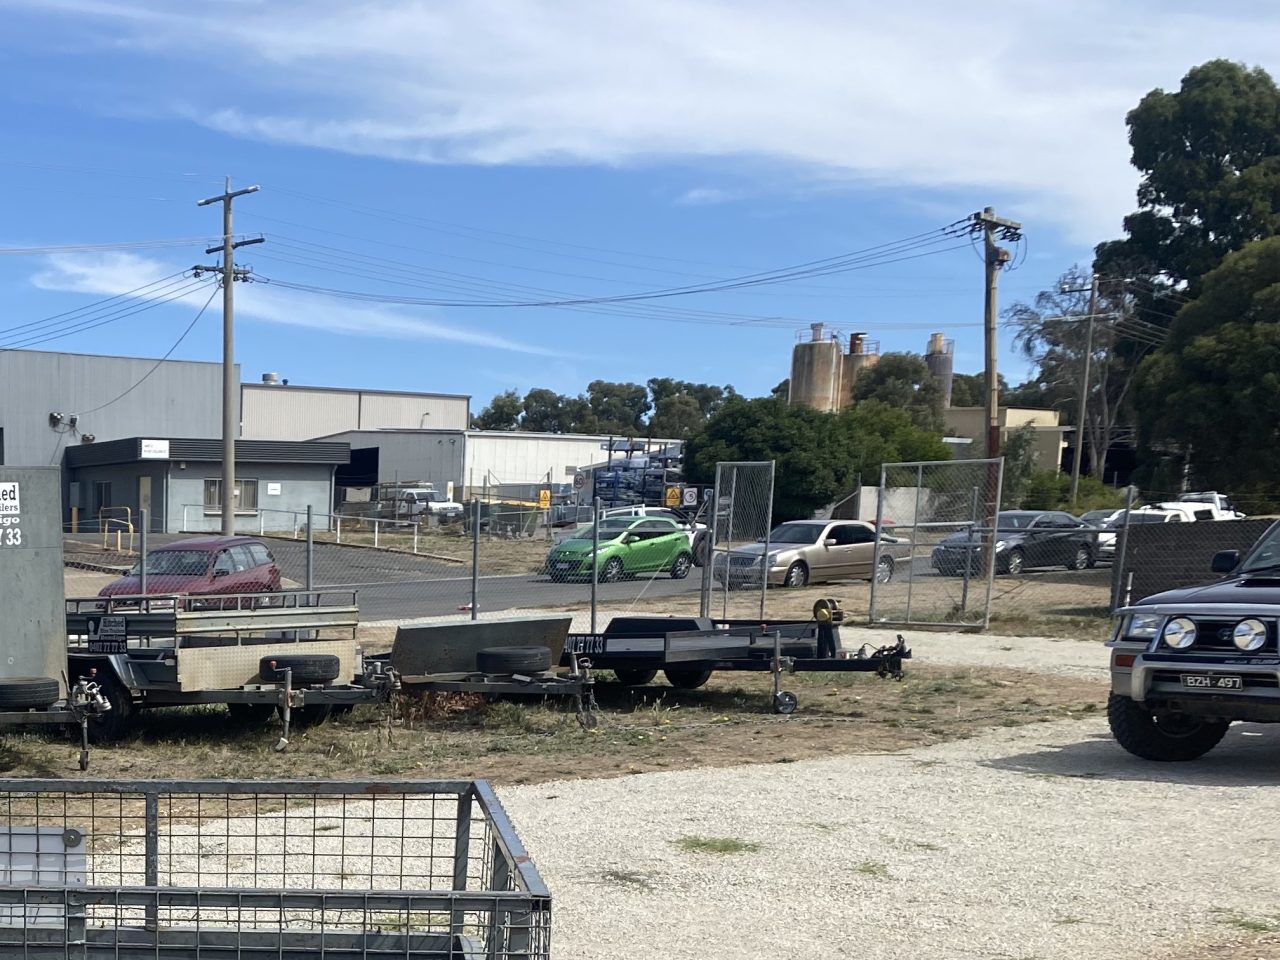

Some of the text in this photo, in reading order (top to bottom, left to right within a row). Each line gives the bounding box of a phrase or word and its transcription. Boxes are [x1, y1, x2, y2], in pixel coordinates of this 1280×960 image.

[6, 528, 21, 545] 33
[586, 636, 594, 653] 77
[594, 636, 603, 653] 33
